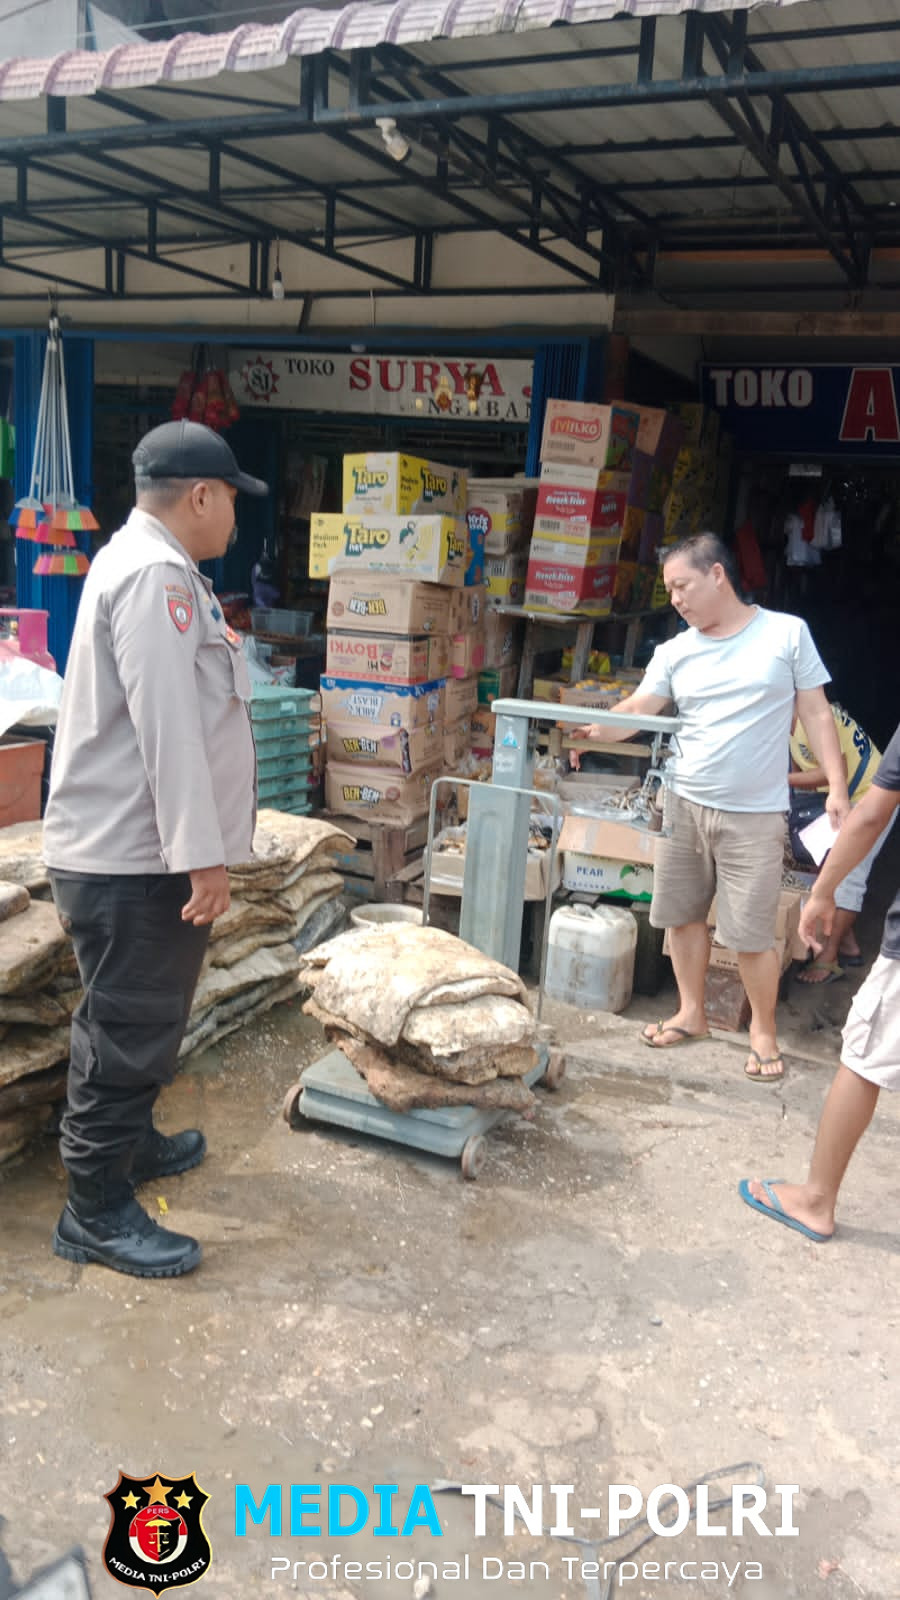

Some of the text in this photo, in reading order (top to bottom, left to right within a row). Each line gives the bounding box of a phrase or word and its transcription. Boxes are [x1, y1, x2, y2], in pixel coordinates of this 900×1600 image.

[284, 358, 505, 396] TOKO SURYA
[709, 369, 814, 407] TOKO
[353, 466, 389, 486] Taro
[421, 466, 448, 491] Taro
[345, 522, 390, 546] Taro
[329, 639, 379, 660] BOYKI
[576, 866, 603, 877] PEAR
